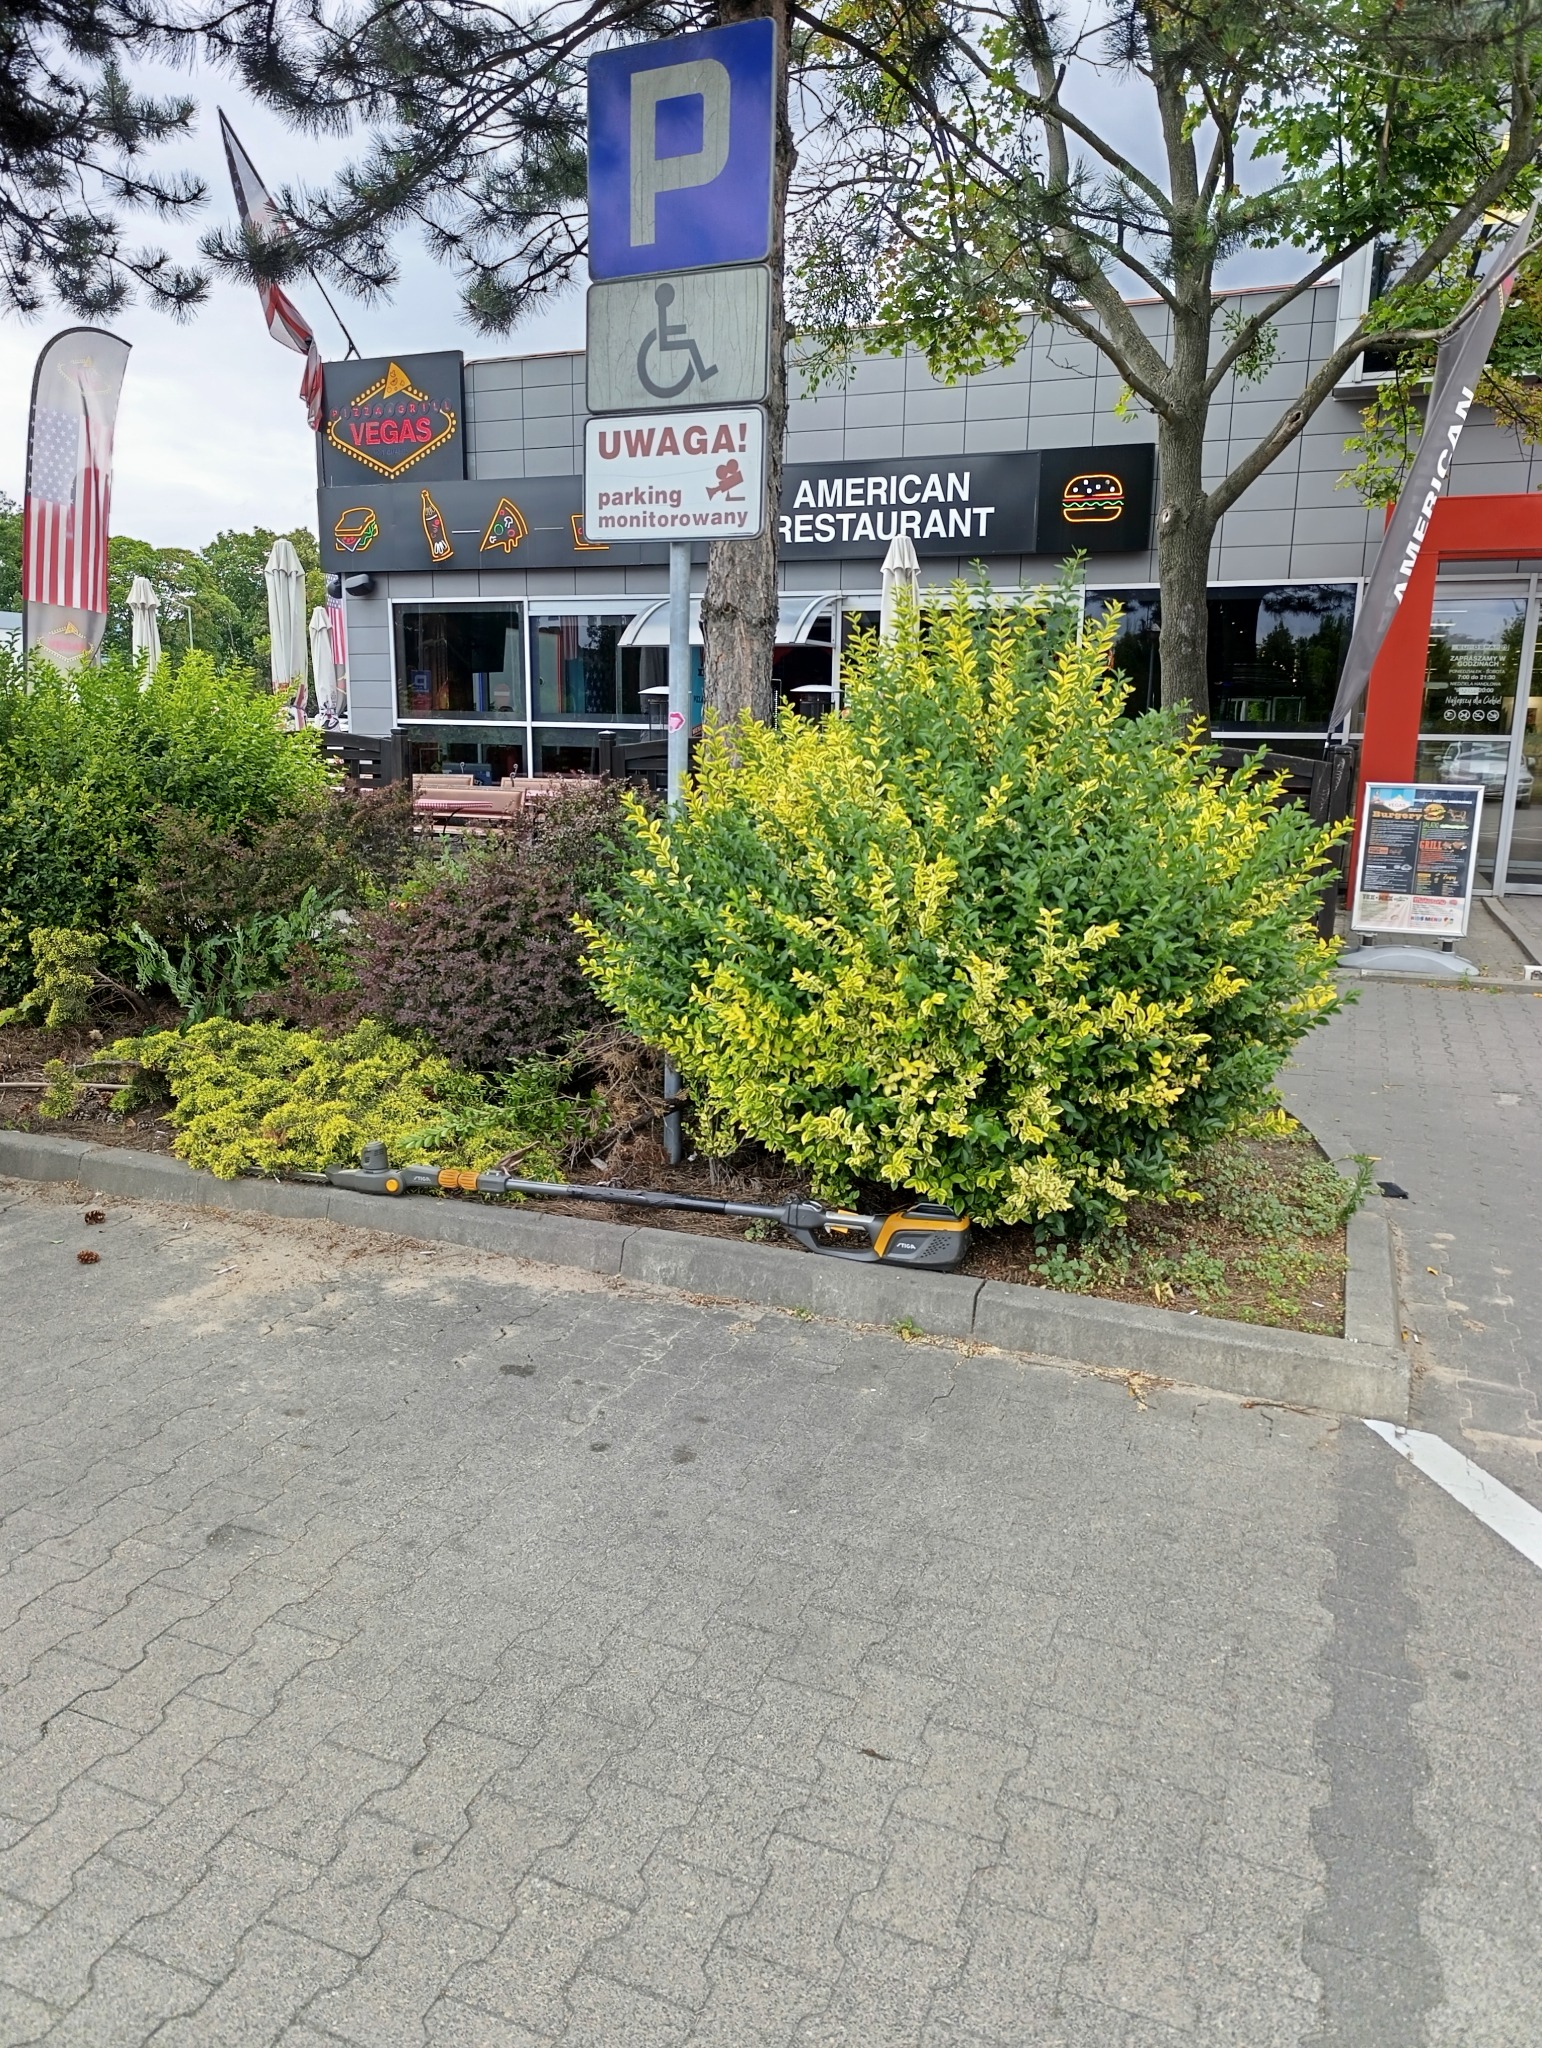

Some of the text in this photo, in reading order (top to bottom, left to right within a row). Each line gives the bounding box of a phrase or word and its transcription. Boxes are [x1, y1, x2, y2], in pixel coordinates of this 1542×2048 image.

[630, 58, 731, 247] P
[331, 406, 382, 418] PIZZA
[397, 401, 450, 414] GRILL
[349, 417, 432, 445] VEGAS
[599, 423, 747, 460] UWAGA!
[598, 485, 682, 510] parking
[793, 471, 970, 509] AMERICAN
[1393, 386, 1475, 605] AMERICAN
[598, 511, 748, 528] monitorowany
[778, 506, 995, 543] RESTAURANT
[1473, 696, 1482, 705] dla
[1372, 810, 1423, 820] Burgery
[1420, 841, 1442, 850] GRILL
